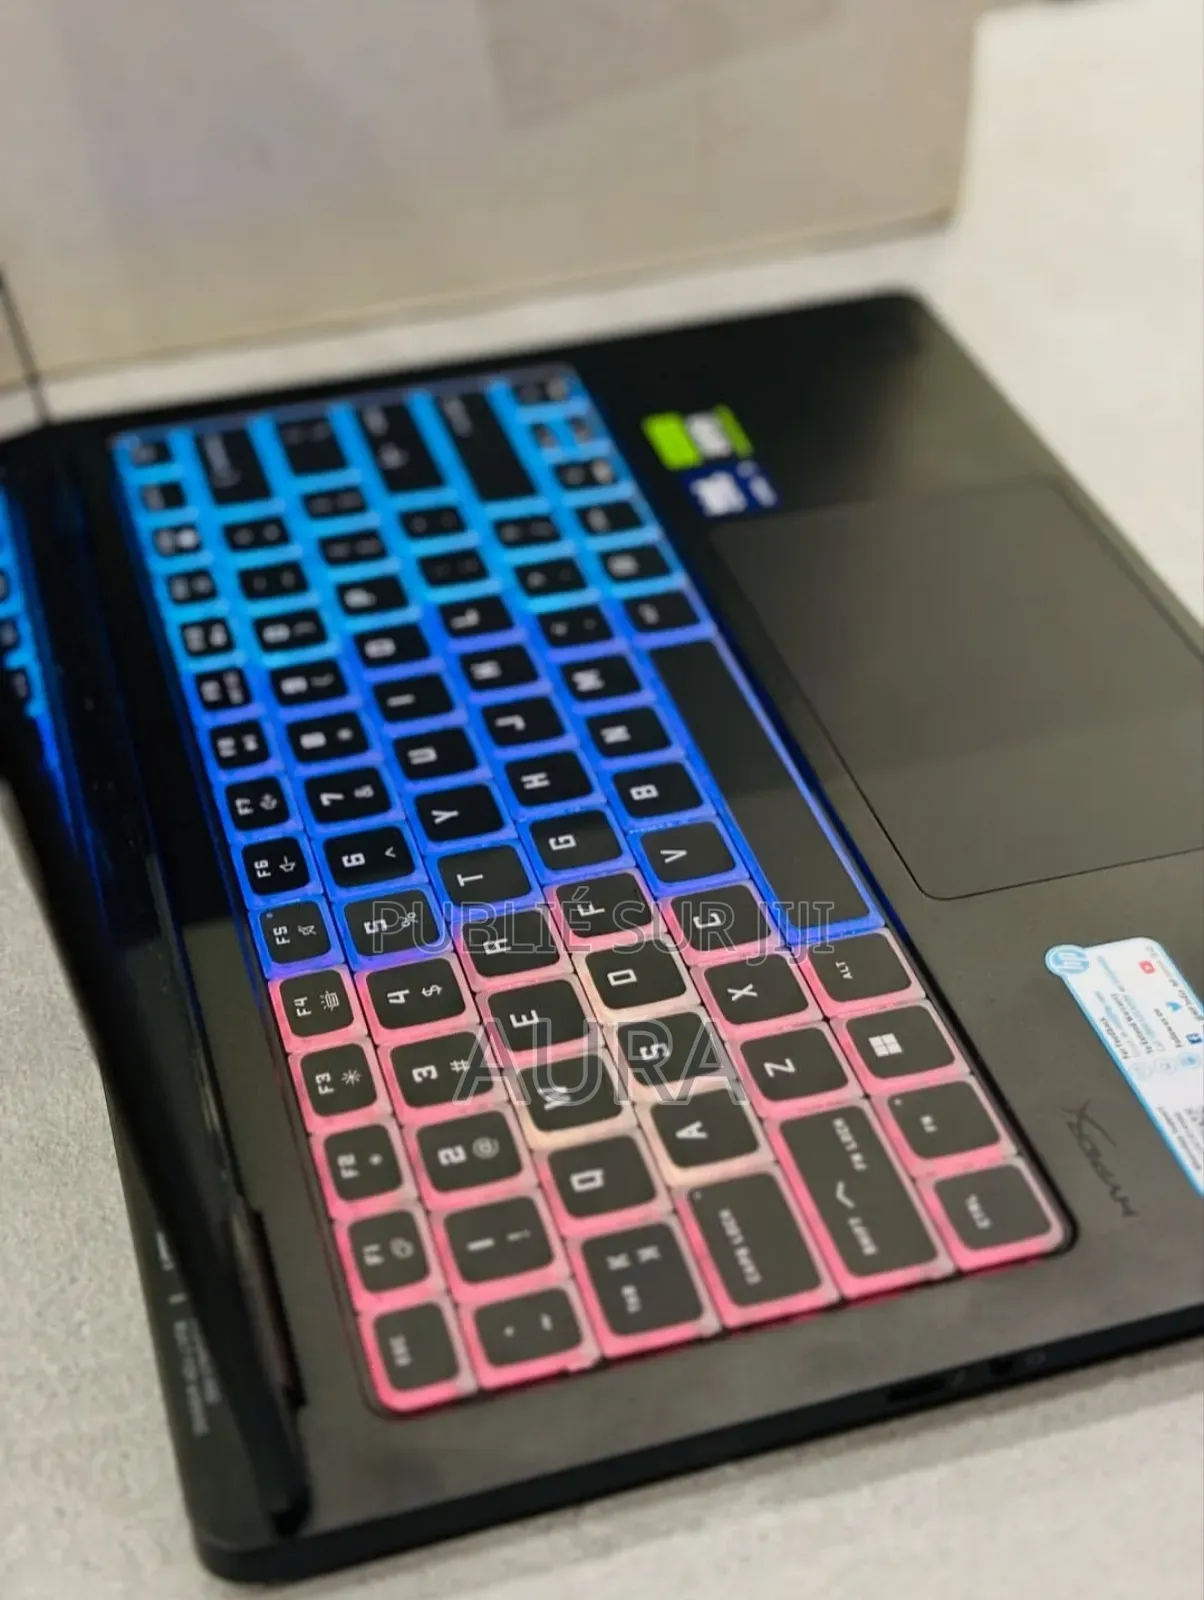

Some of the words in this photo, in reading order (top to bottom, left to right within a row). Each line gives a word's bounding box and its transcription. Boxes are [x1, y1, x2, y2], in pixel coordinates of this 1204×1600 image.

[495, 714, 526, 731] J
[601, 725, 630, 744] N
[408, 747, 438, 765] U
[521, 772, 550, 790] H
[320, 792, 344, 807] 7
[629, 784, 659, 801] B
[431, 810, 459, 824] Y
[548, 834, 577, 851] G
[341, 852, 366, 868] 6
[659, 849, 687, 864] V
[253, 859, 272, 878] F6
[456, 873, 484, 887] T
[576, 901, 607, 918] F
[363, 918, 389, 935] 5
[399, 910, 420, 930] %
[692, 912, 724, 931] C
[272, 925, 291, 945] F5
[483, 936, 513, 956] R
[607, 968, 638, 987] D
[835, 961, 853, 980] ALT
[386, 989, 410, 1004] 4
[421, 984, 443, 997] $
[727, 983, 758, 1002] X
[293, 996, 312, 1017] F4
[509, 1009, 541, 1029] E
[639, 1042, 672, 1061] S
[411, 1064, 438, 1083] 3
[449, 1057, 471, 1075] #
[763, 1058, 796, 1078] Z
[315, 1072, 335, 1095] F3
[675, 1121, 707, 1139] A
[437, 1145, 467, 1166] 2
[472, 1137, 499, 1159] @
[570, 1169, 604, 1192] Q
[467, 1238, 495, 1251] 1
